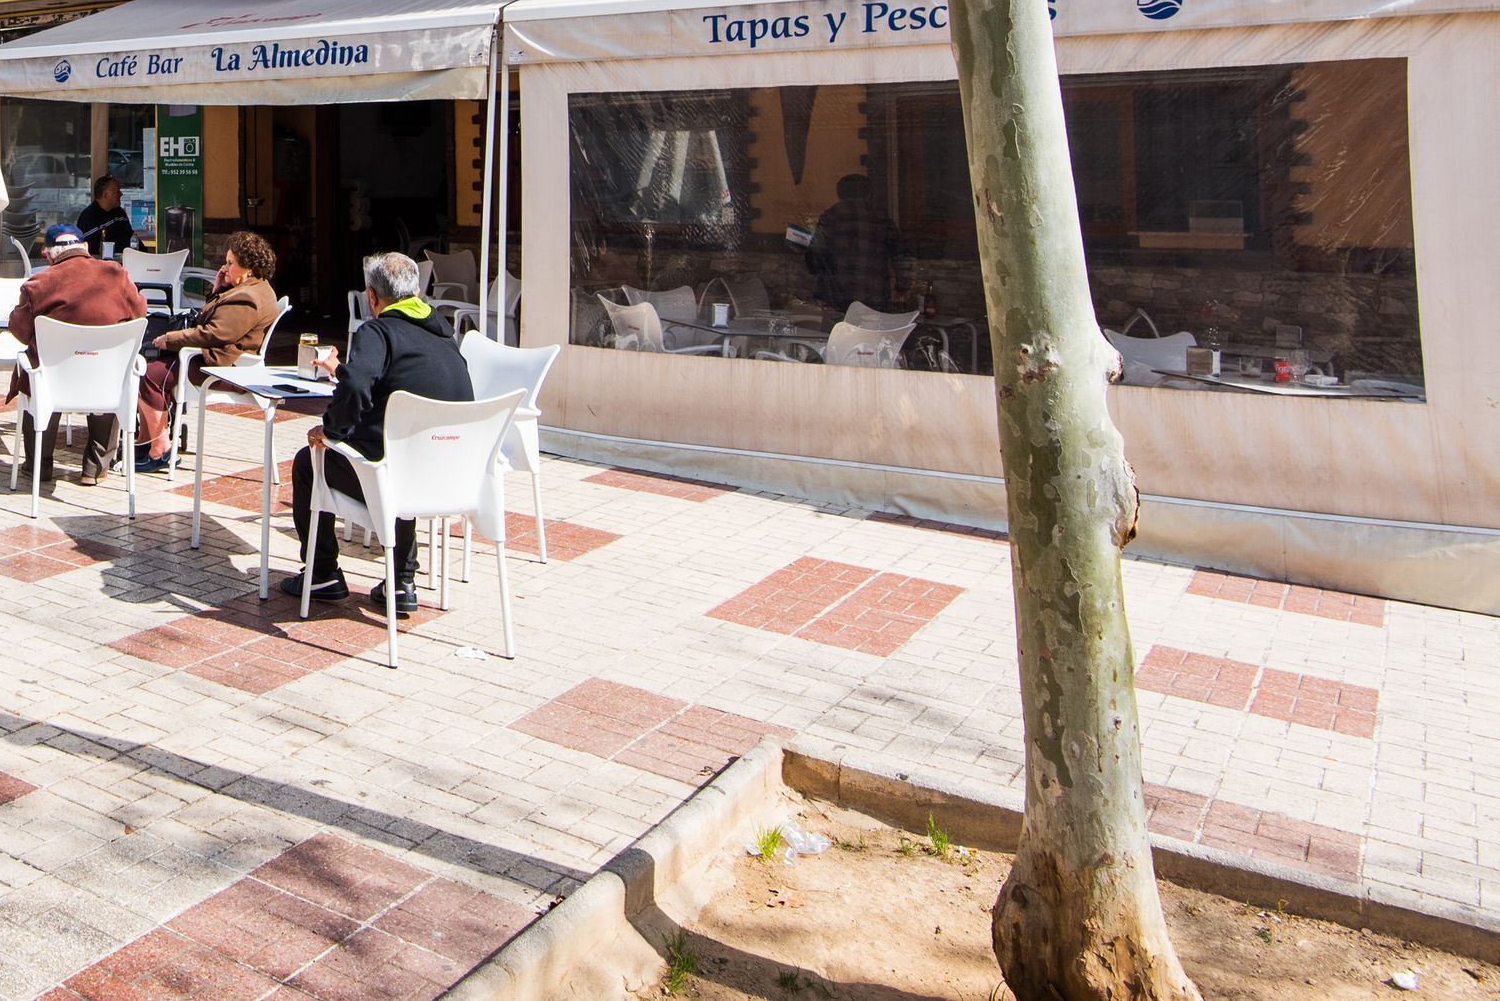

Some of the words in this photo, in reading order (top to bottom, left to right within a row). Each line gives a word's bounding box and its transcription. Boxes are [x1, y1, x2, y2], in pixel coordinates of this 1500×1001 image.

[702, 13, 810, 49] Tapas
[824, 11, 846, 43] y
[96, 55, 136, 79] Café
[146, 54, 184, 75] Bar
[211, 47, 240, 72] La
[248, 39, 368, 71] Almedina
